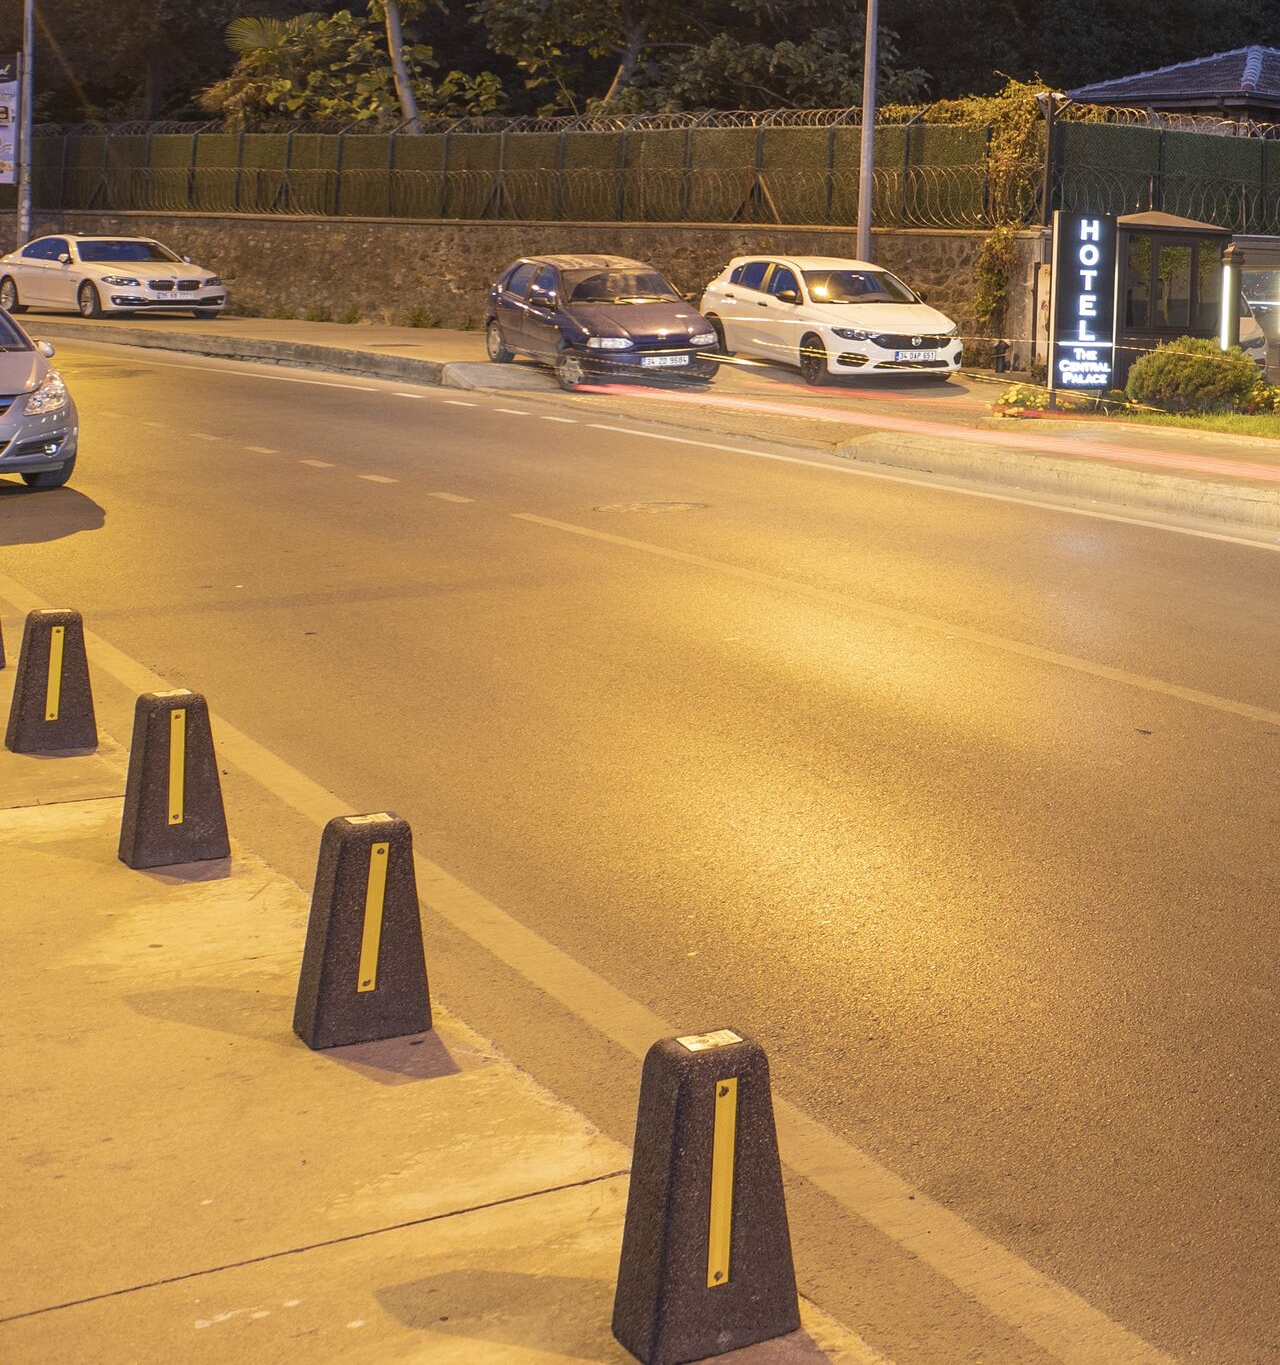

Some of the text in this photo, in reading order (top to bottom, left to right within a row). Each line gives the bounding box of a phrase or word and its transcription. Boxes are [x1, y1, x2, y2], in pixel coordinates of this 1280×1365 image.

[1078, 219, 1100, 342] HOTEL
[1073, 347, 1098, 361] THE
[1058, 359, 1112, 373] CENTRAL
[1062, 372, 1108, 385] PALACE
